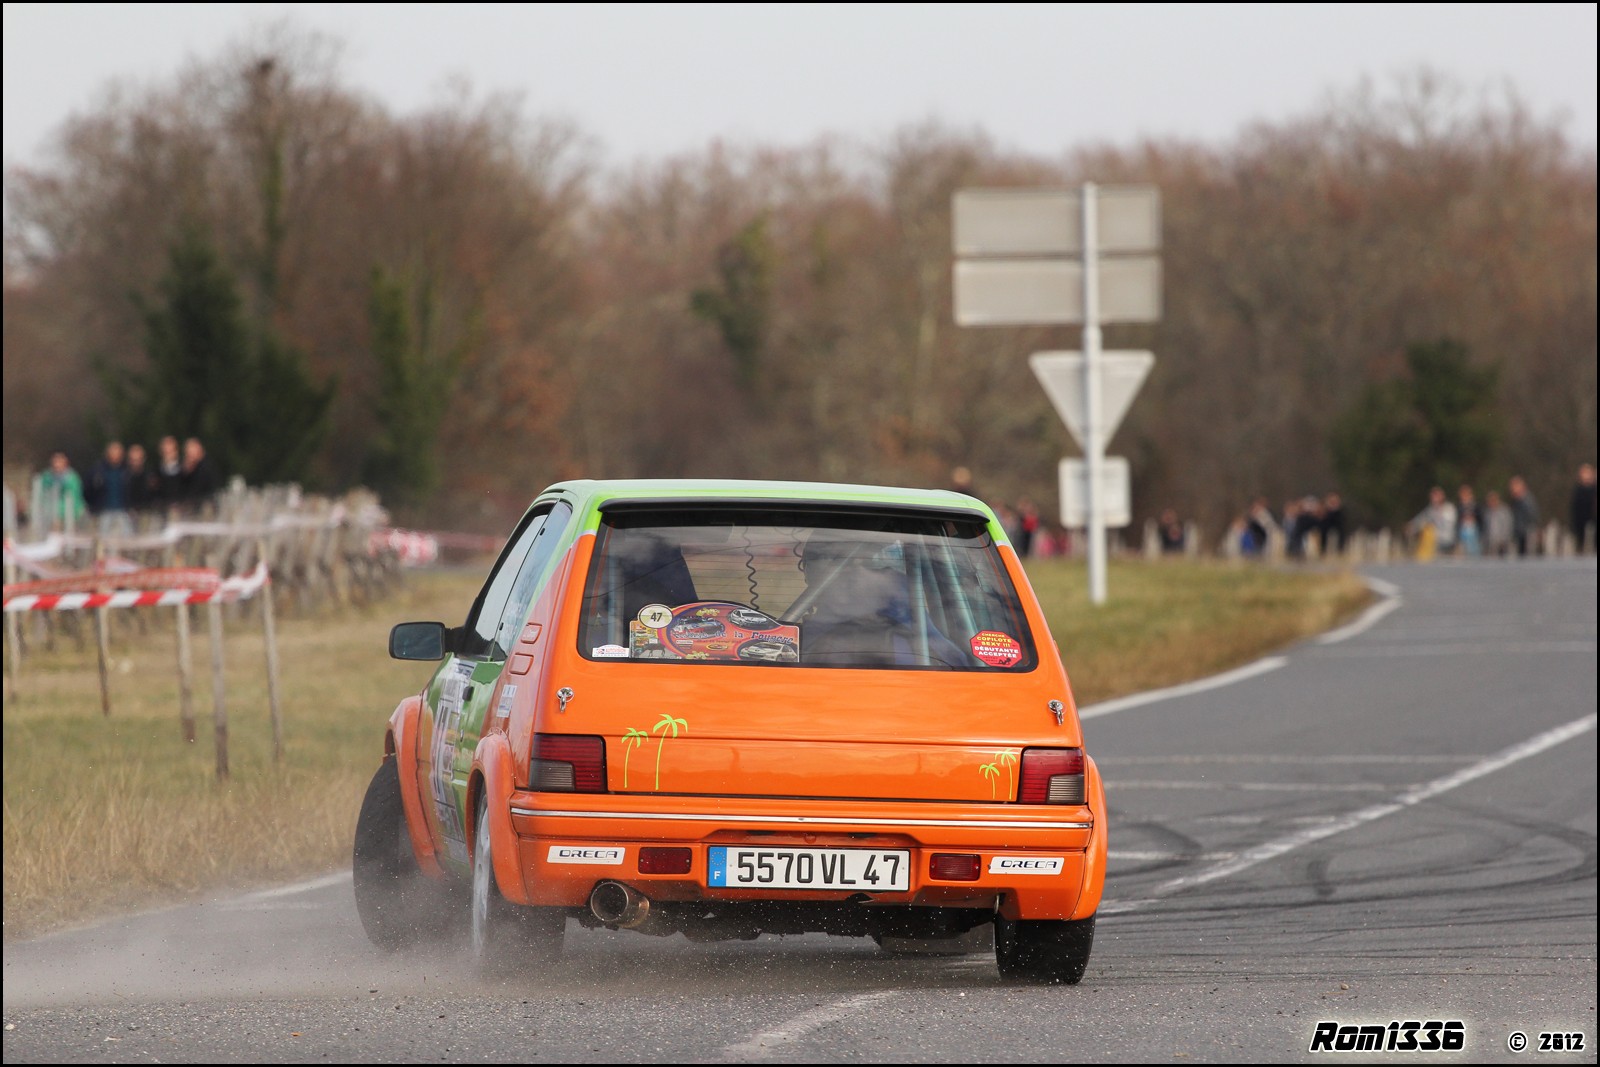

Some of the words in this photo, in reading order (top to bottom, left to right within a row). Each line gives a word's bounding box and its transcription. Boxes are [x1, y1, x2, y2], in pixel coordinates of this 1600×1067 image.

[650, 611, 663, 622] 47
[559, 849, 618, 858] ORECA
[737, 851, 814, 884] 5570
[820, 853, 856, 885] VL
[863, 854, 900, 885] 47
[1000, 860, 1057, 868] ORECA
[713, 870, 721, 880] F
